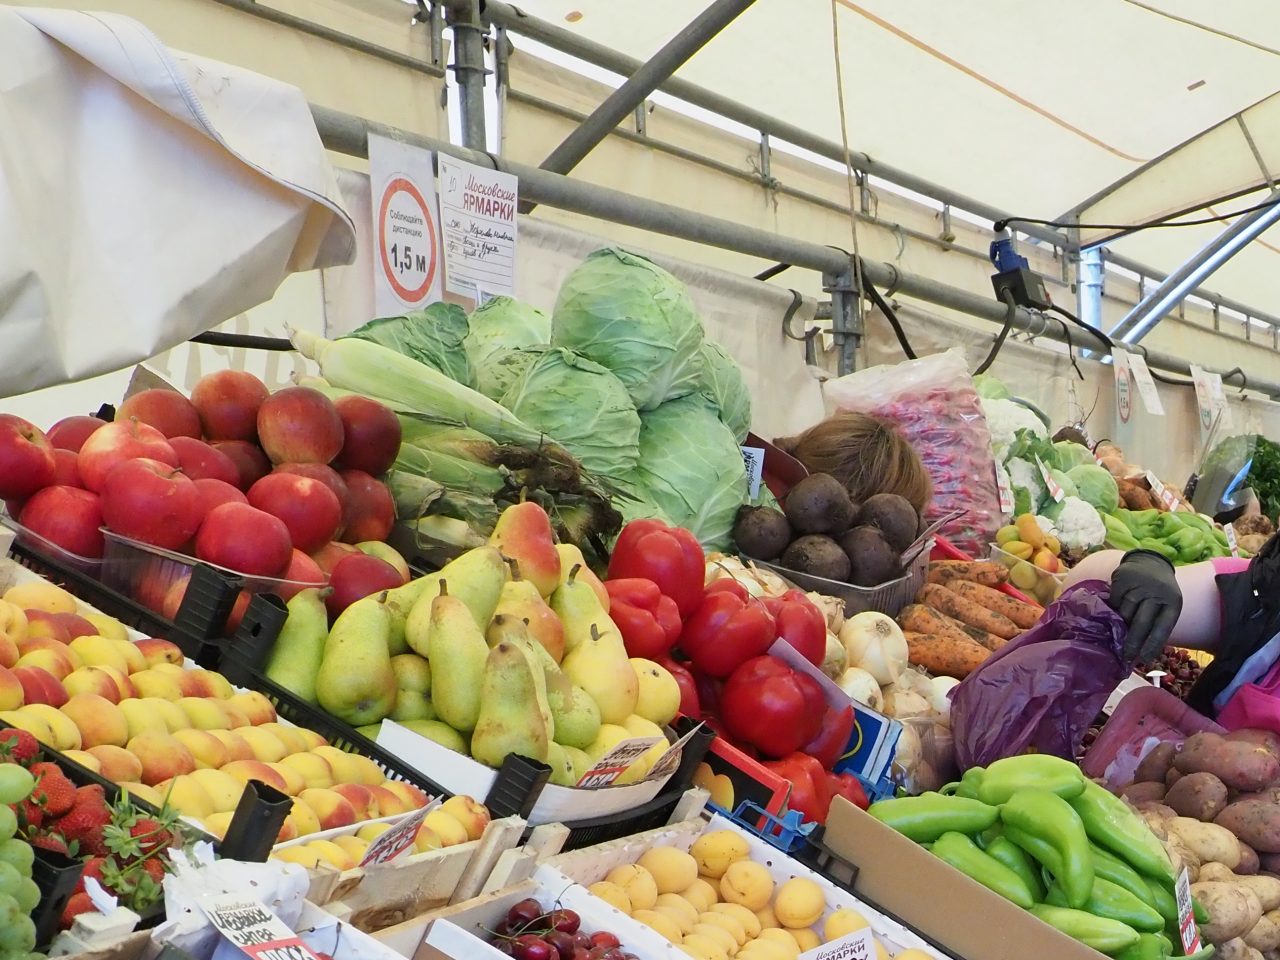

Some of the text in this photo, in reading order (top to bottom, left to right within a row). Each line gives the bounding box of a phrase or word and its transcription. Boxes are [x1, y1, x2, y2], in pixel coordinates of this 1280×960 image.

[464, 172, 516, 202] Московские
[389, 209, 423, 225] Соблюдайте
[463, 192, 514, 222] ЯРМАРКИ
[392, 225, 422, 238] дистанцию
[391, 243, 412, 274] 1,5
